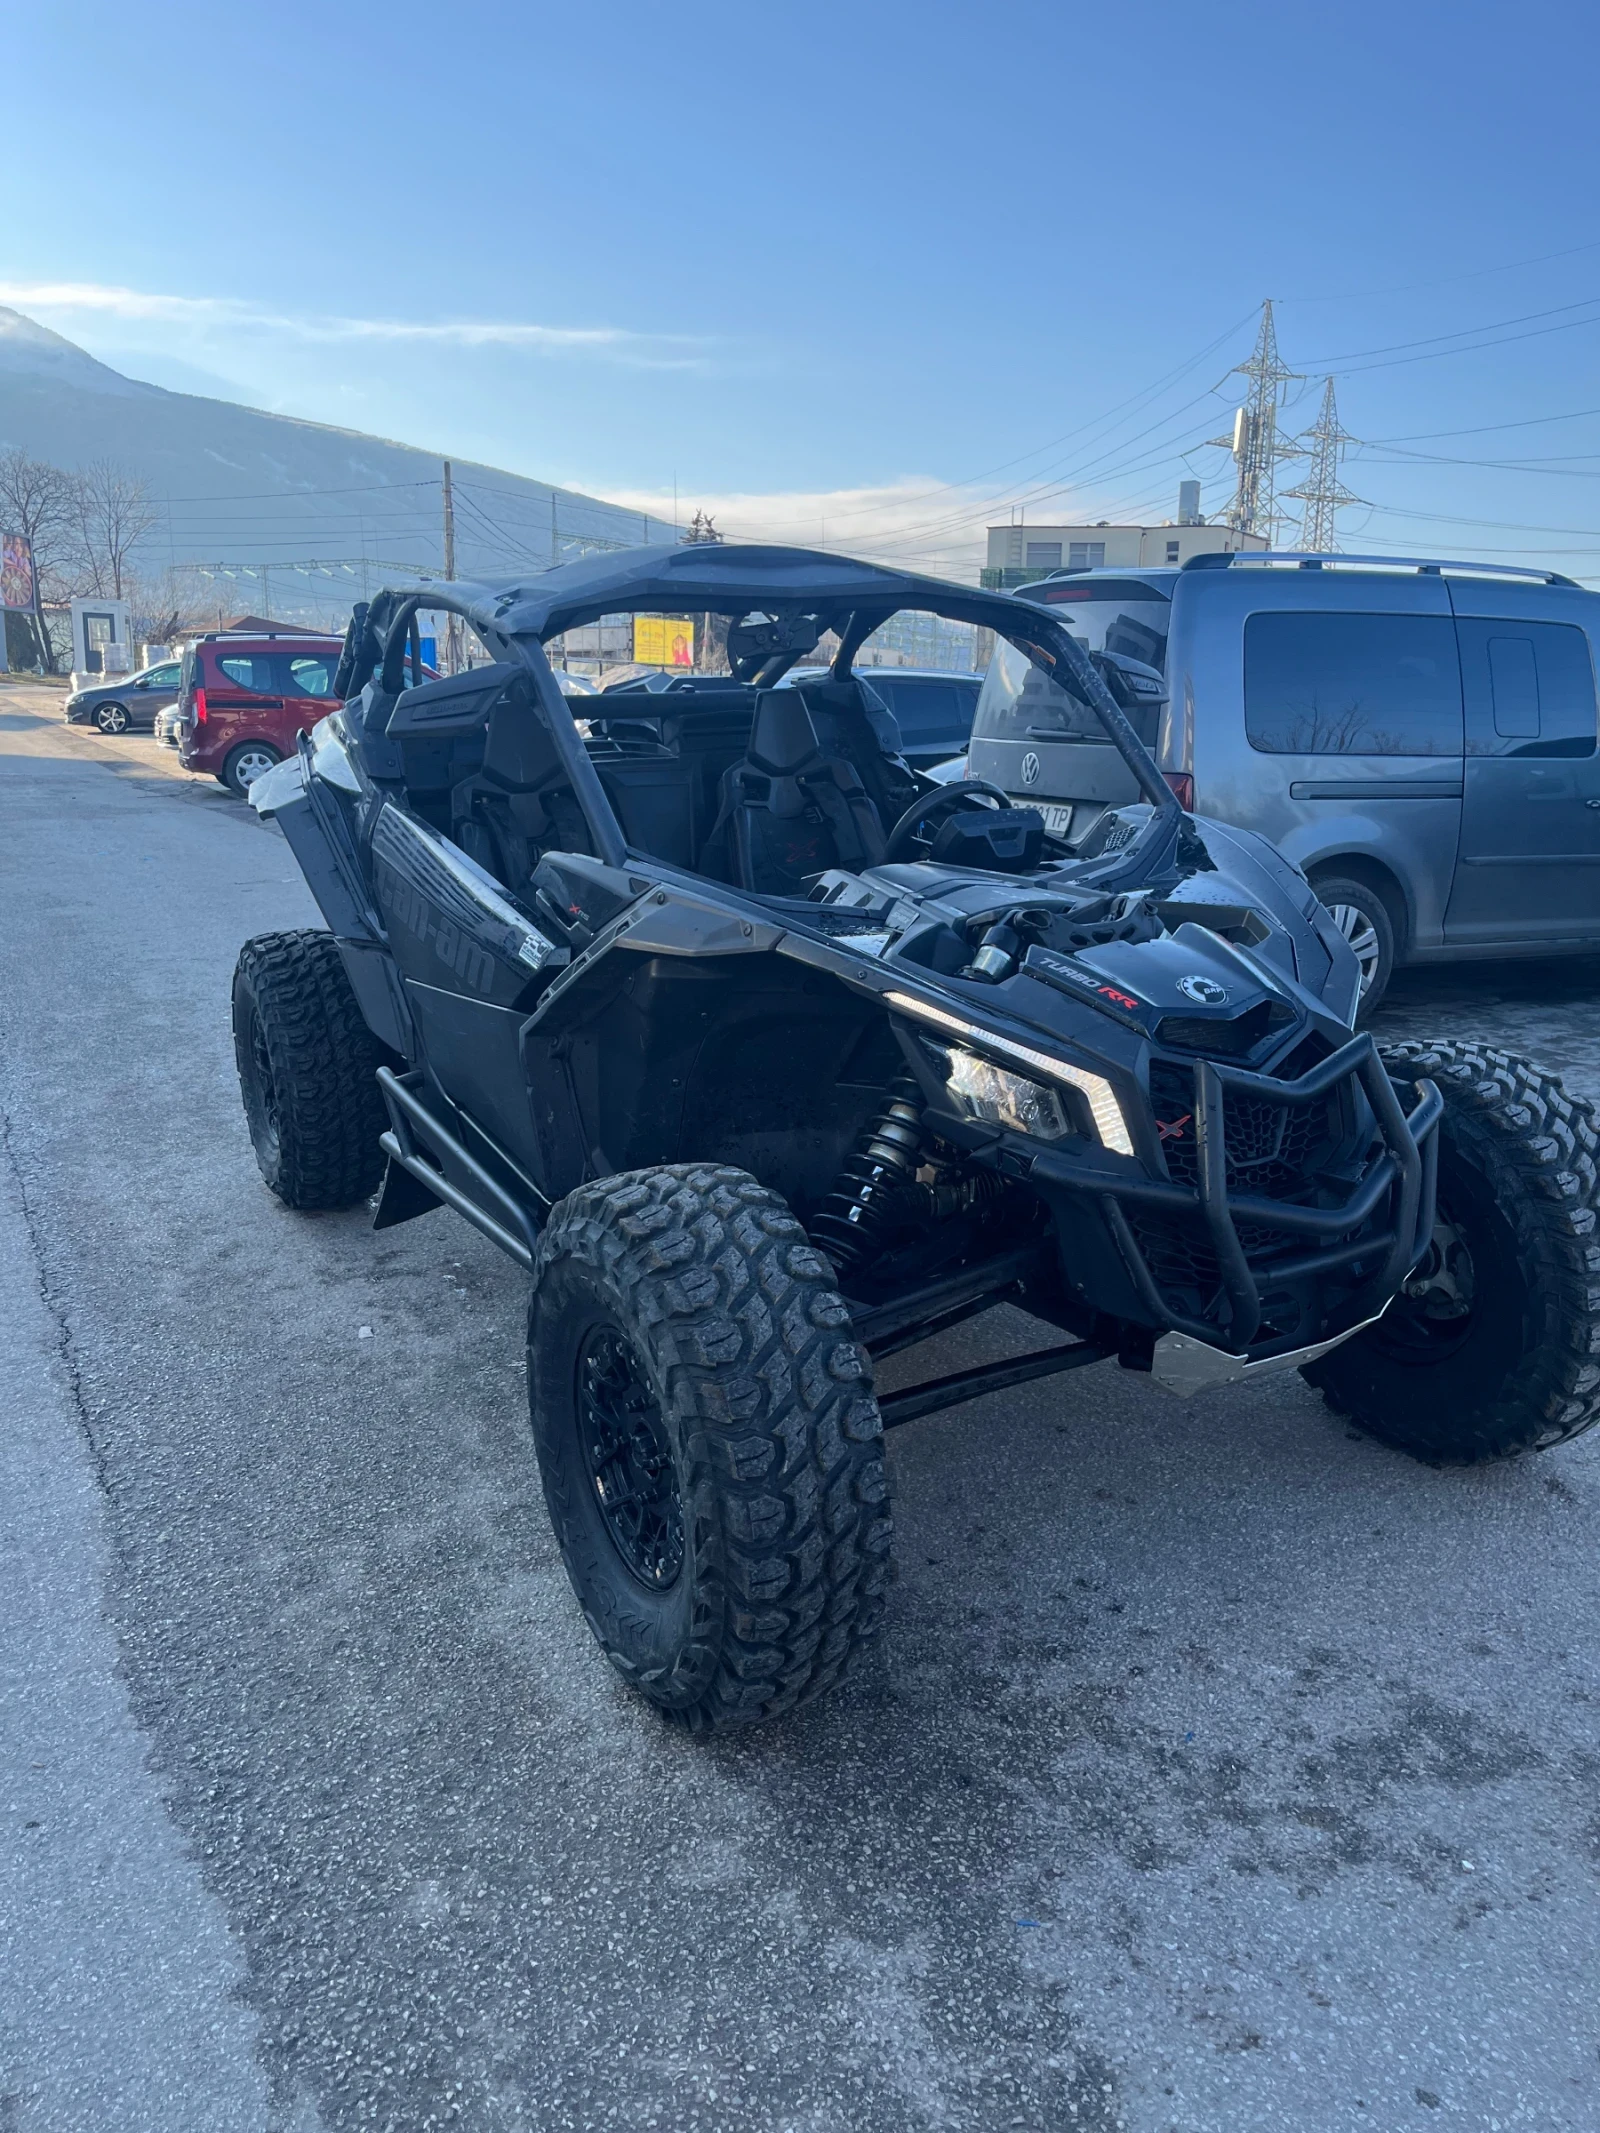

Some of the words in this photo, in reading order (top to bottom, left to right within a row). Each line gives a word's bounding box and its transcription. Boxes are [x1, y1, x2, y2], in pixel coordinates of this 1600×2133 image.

[1040, 957, 1102, 988] TURBO
[1097, 986, 1139, 1010] RR
[1203, 987, 1223, 995] BRP
